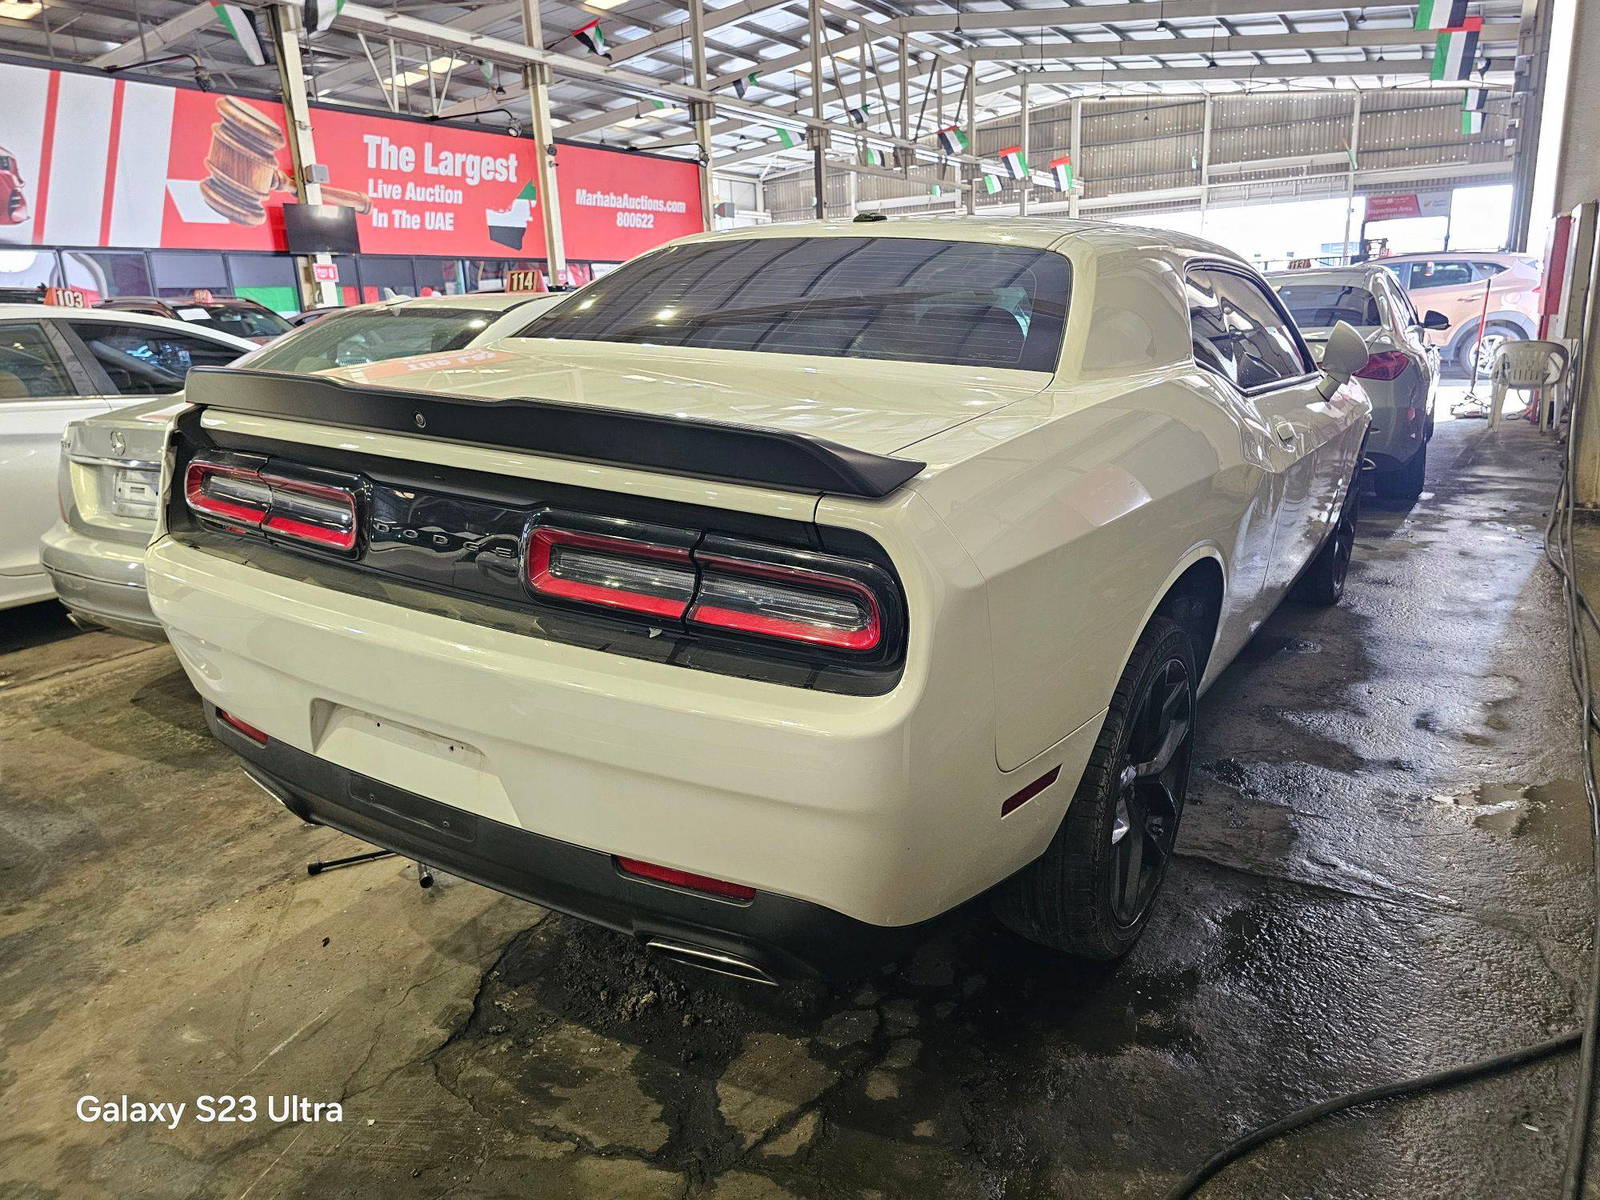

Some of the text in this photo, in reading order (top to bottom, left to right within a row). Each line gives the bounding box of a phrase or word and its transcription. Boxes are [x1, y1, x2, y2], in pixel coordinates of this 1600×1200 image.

[363, 134, 518, 186] The Largest
[368, 178, 463, 204] Live Auction
[575, 188, 687, 214] MarhabaAuctions.com
[371, 208, 455, 231] In The UAE
[616, 211, 655, 229] 800622
[511, 271, 534, 291] 114
[56, 289, 84, 308] 103
[372, 521, 513, 559] DODGE
